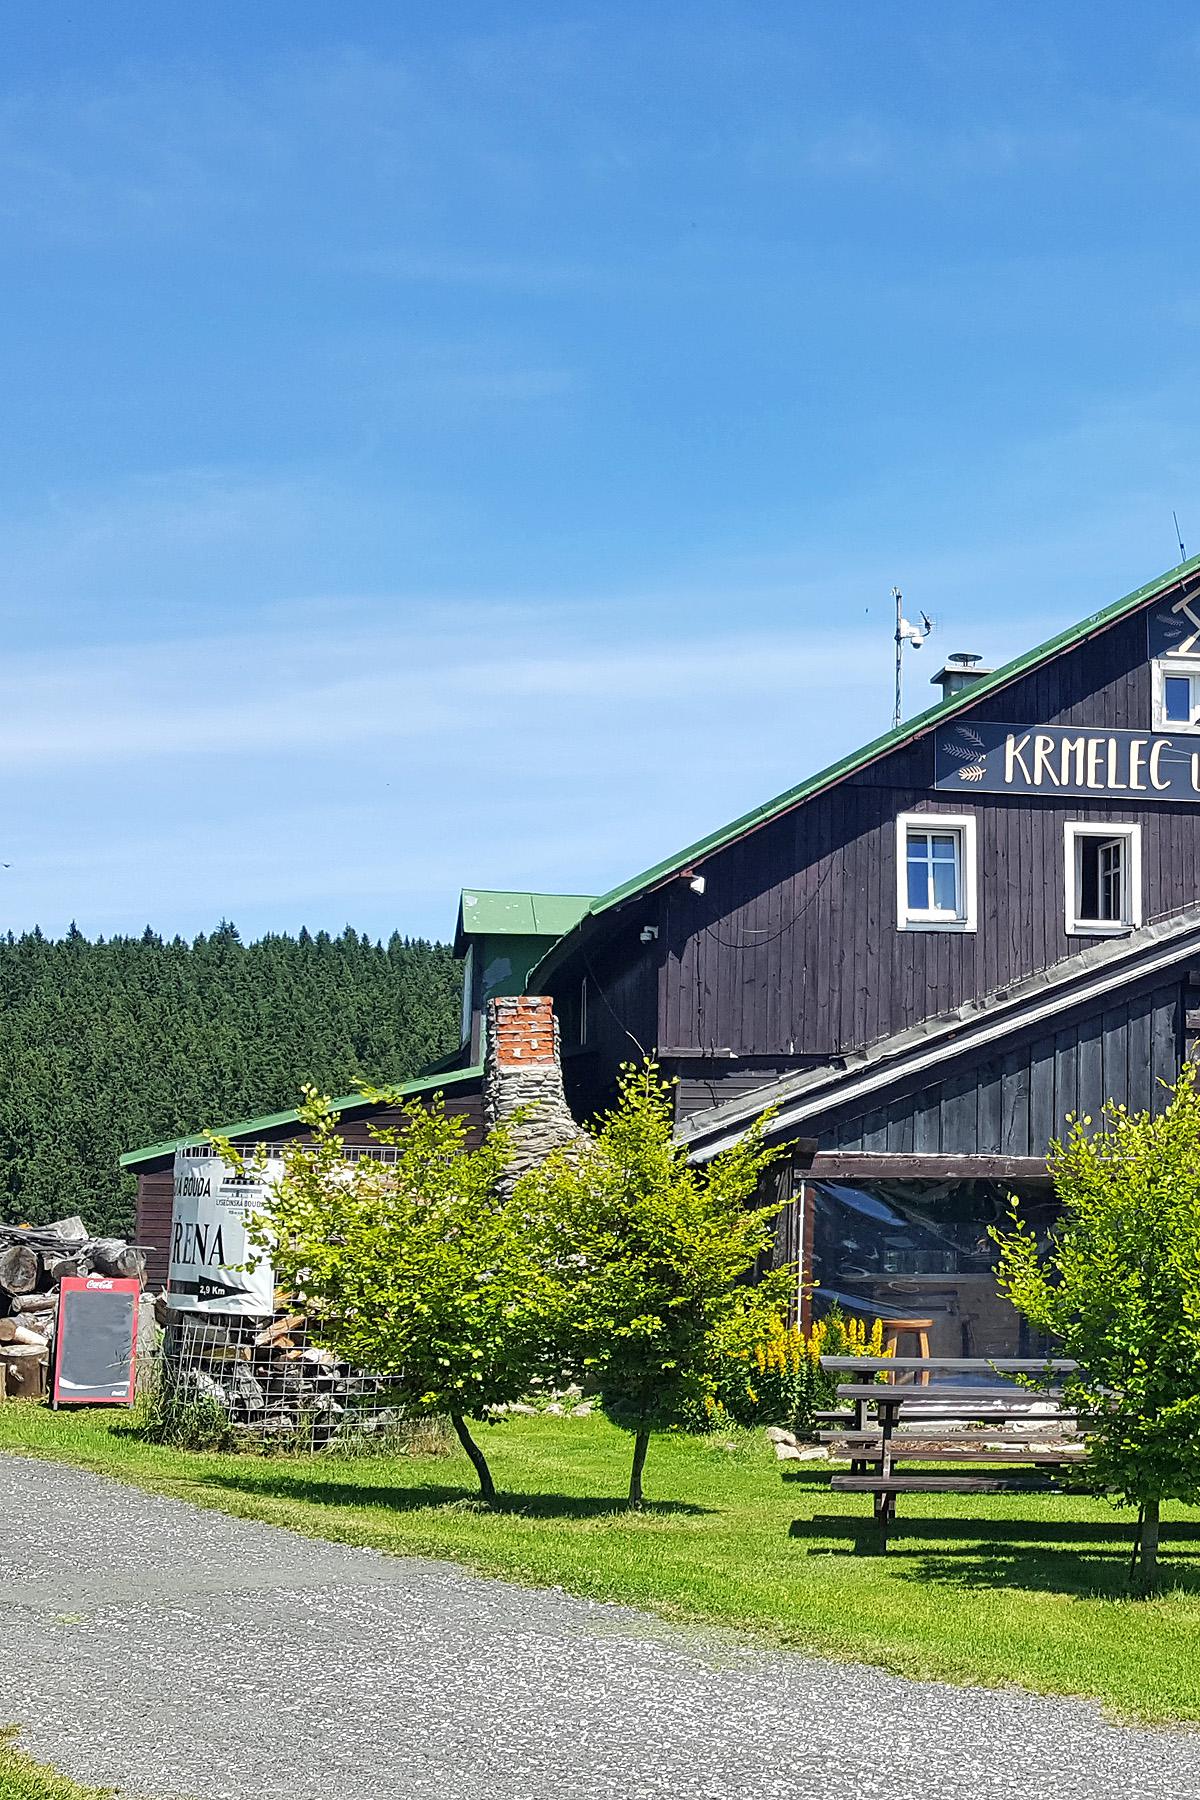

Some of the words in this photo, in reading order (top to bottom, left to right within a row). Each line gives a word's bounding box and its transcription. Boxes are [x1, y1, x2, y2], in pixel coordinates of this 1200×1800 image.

[1004, 733, 1173, 791] KRMELEC
[183, 1176, 211, 1198] BOUDA
[199, 1285, 211, 1295] 2,9
[212, 1286, 226, 1295] Km
